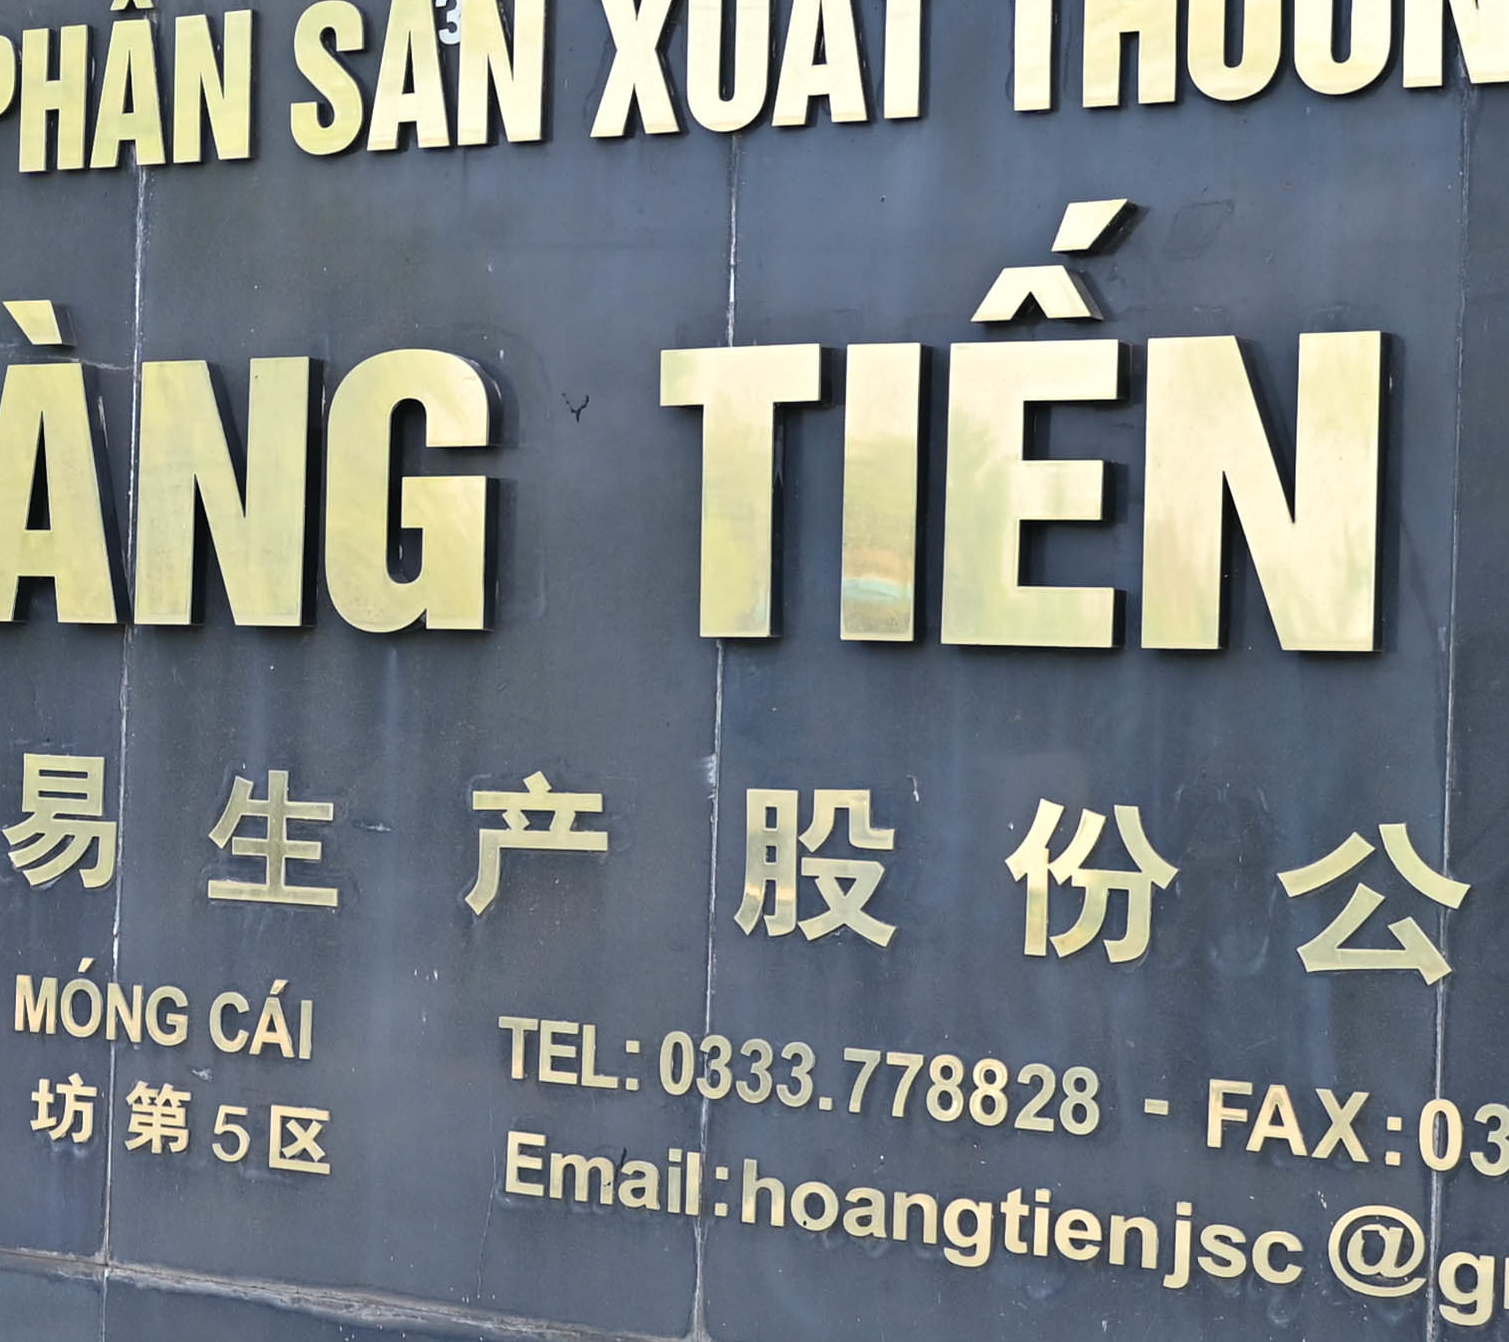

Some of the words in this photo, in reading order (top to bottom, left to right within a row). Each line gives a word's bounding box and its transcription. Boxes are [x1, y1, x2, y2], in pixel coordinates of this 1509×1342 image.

[659, 197, 1387, 654] TIẾN
[14, 957, 188, 1047] MÓNG
[208, 979, 313, 1060] CÁI
[498, 1016, 641, 1092] TEL:
[659, 1029, 1100, 1137] 0333.778828
